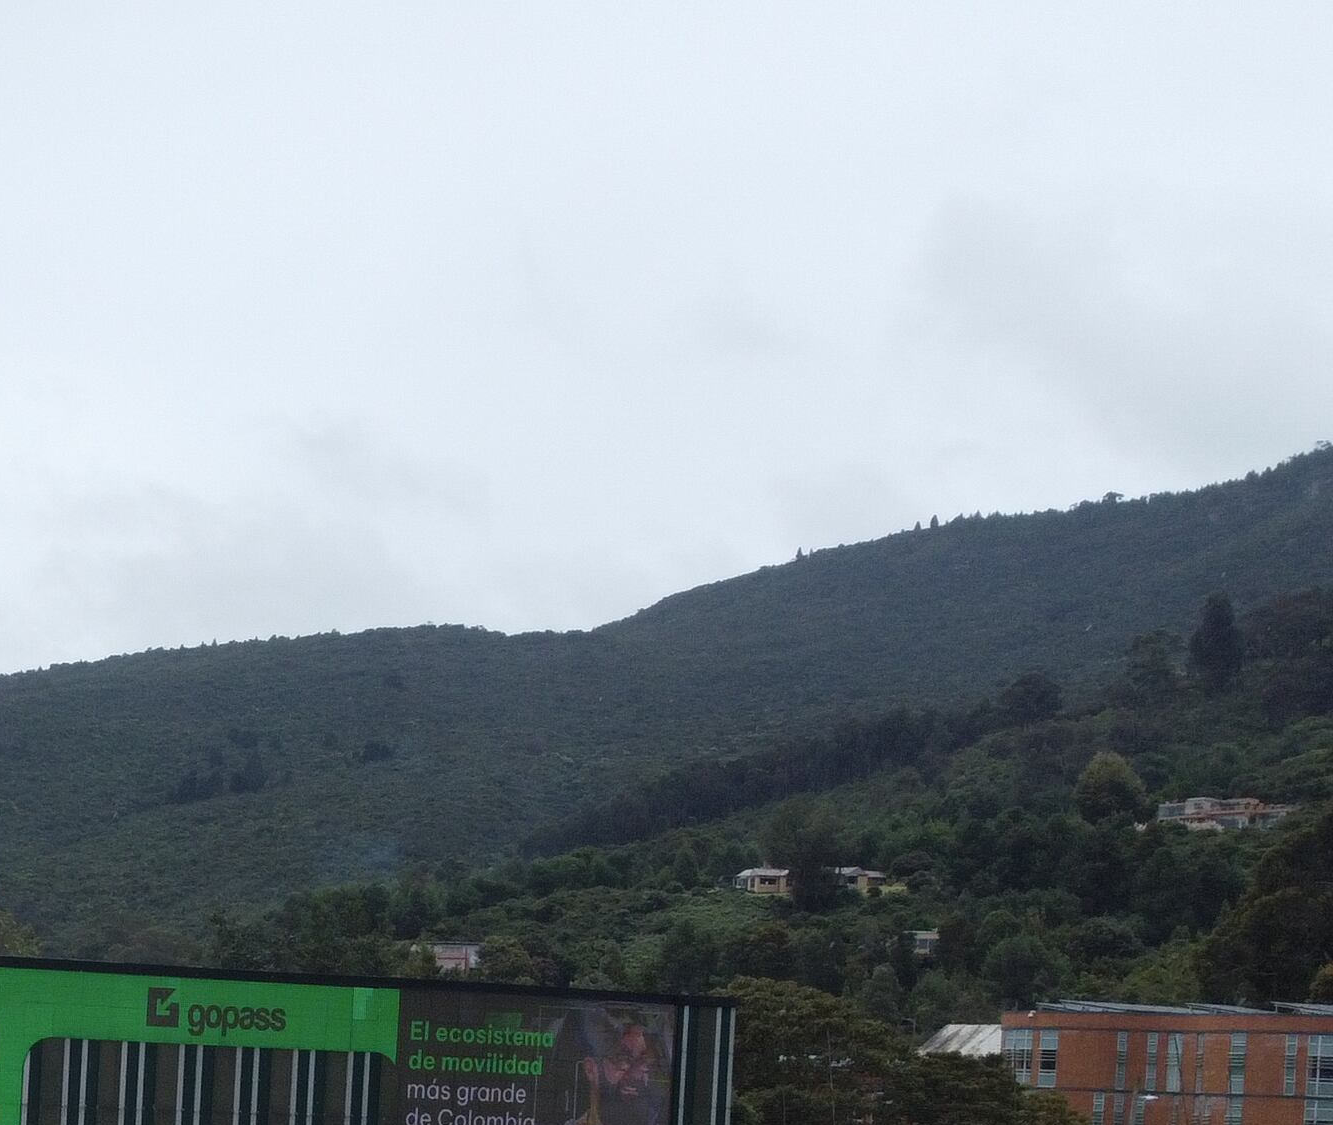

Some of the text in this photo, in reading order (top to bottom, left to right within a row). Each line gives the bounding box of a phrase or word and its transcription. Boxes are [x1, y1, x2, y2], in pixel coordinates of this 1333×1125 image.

[187, 1002, 287, 1037] gopass
[410, 1021, 554, 1048] El ecosistema
[408, 1050, 543, 1075] de movilidad
[406, 1078, 527, 1109] más grande
